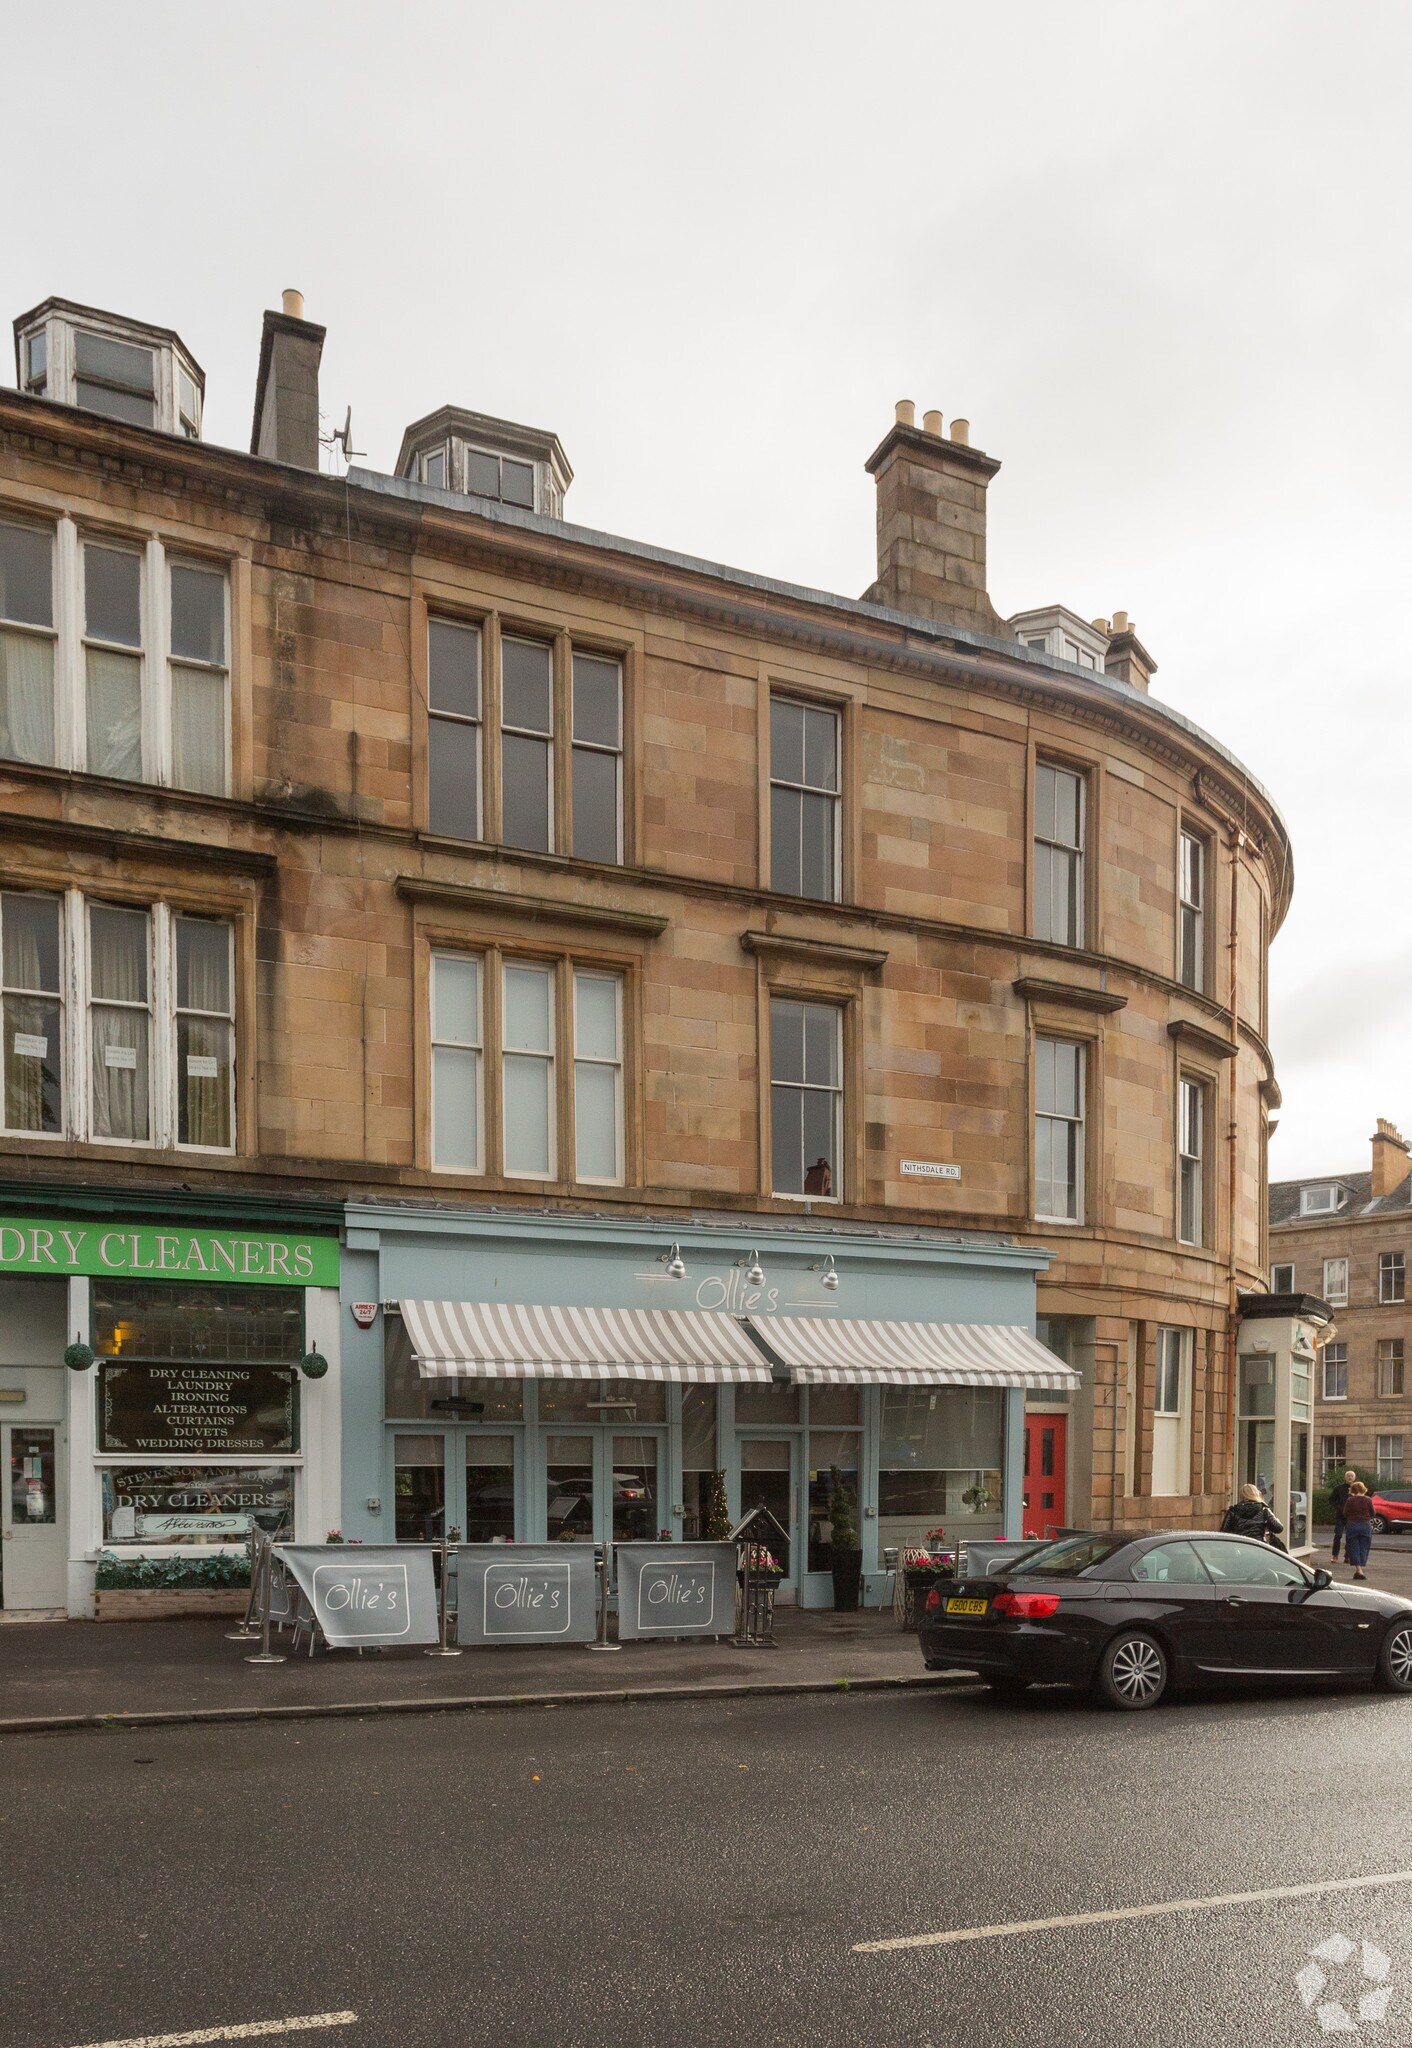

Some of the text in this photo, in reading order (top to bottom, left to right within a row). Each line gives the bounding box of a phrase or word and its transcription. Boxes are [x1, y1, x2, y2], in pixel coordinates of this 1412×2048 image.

[904, 1164, 957, 1176] NITHSDALE RD.
[0, 1227, 314, 1277] DRY CLEANERS
[695, 1268, 779, 1312] Ollie's
[149, 1368, 250, 1380] DRY CLEANING
[167, 1381, 233, 1391] LAUNDRY
[171, 1392, 230, 1402] IRONING
[153, 1404, 248, 1415] ALTERATIONS
[166, 1416, 235, 1425] CURTAINS
[174, 1427, 229, 1437] DUVETS
[136, 1439, 265, 1449] WEDDING DRESSES
[116, 1466, 200, 1487] STEVENSON
[206, 1466, 236, 1477] AND
[116, 1492, 276, 1508] DRY CLEANERS
[325, 1578, 397, 1610] Ollie's
[495, 1577, 560, 1608] Ollie's
[648, 1575, 705, 1604] Ollie's
[949, 1600, 984, 1612] J500 CBS
